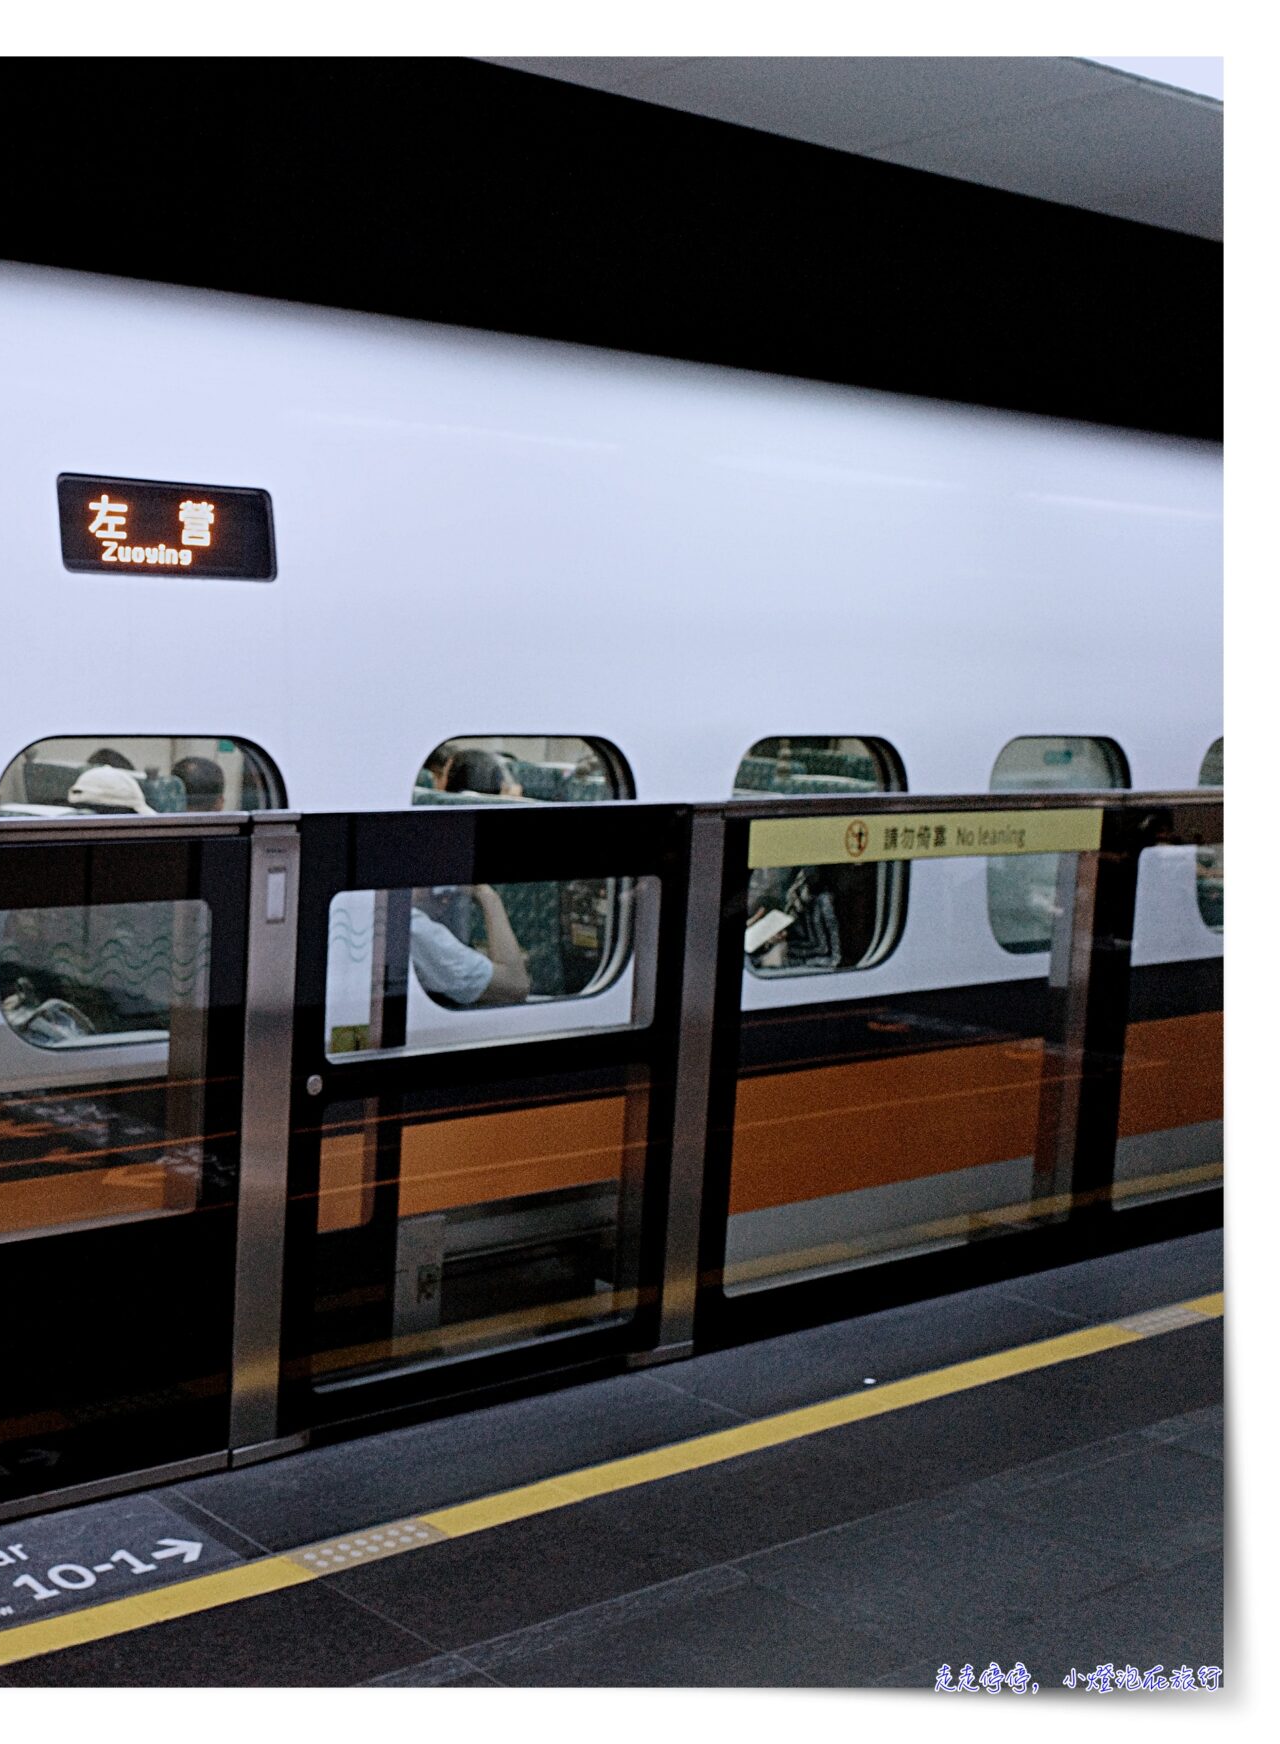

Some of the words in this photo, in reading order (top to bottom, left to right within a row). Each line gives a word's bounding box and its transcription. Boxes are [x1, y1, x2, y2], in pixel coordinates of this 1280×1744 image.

[100, 540, 193, 566] Zuoying
[955, 827, 975, 847] No
[978, 824, 1027, 849] leaning
[12, 1549, 158, 1602] 10-1
